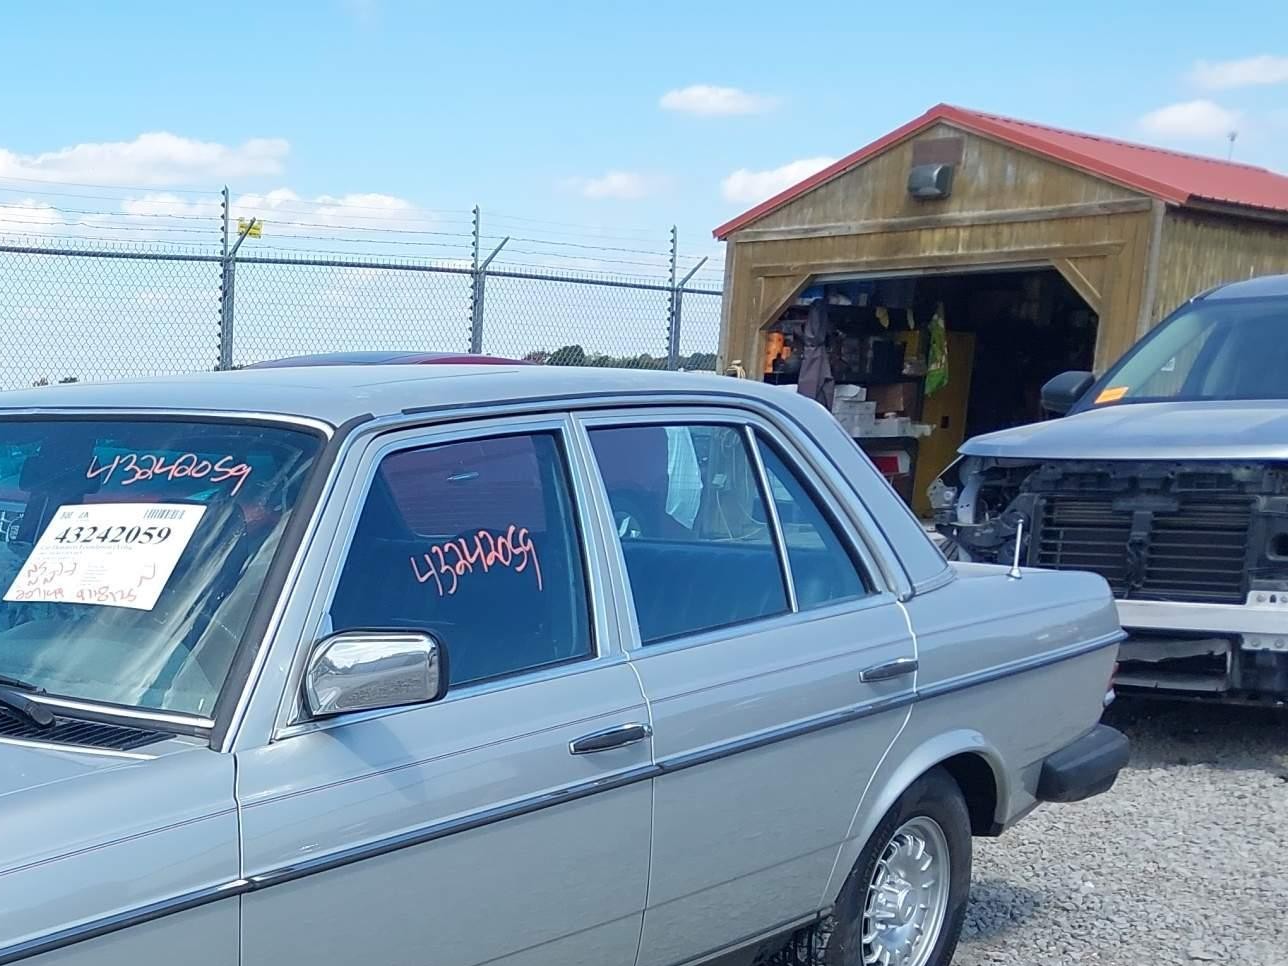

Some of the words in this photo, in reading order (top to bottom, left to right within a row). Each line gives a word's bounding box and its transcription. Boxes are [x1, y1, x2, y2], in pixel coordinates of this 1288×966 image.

[86, 453, 253, 496] 43242059
[54, 526, 172, 545] 43242059
[410, 524, 543, 597] 43242059
